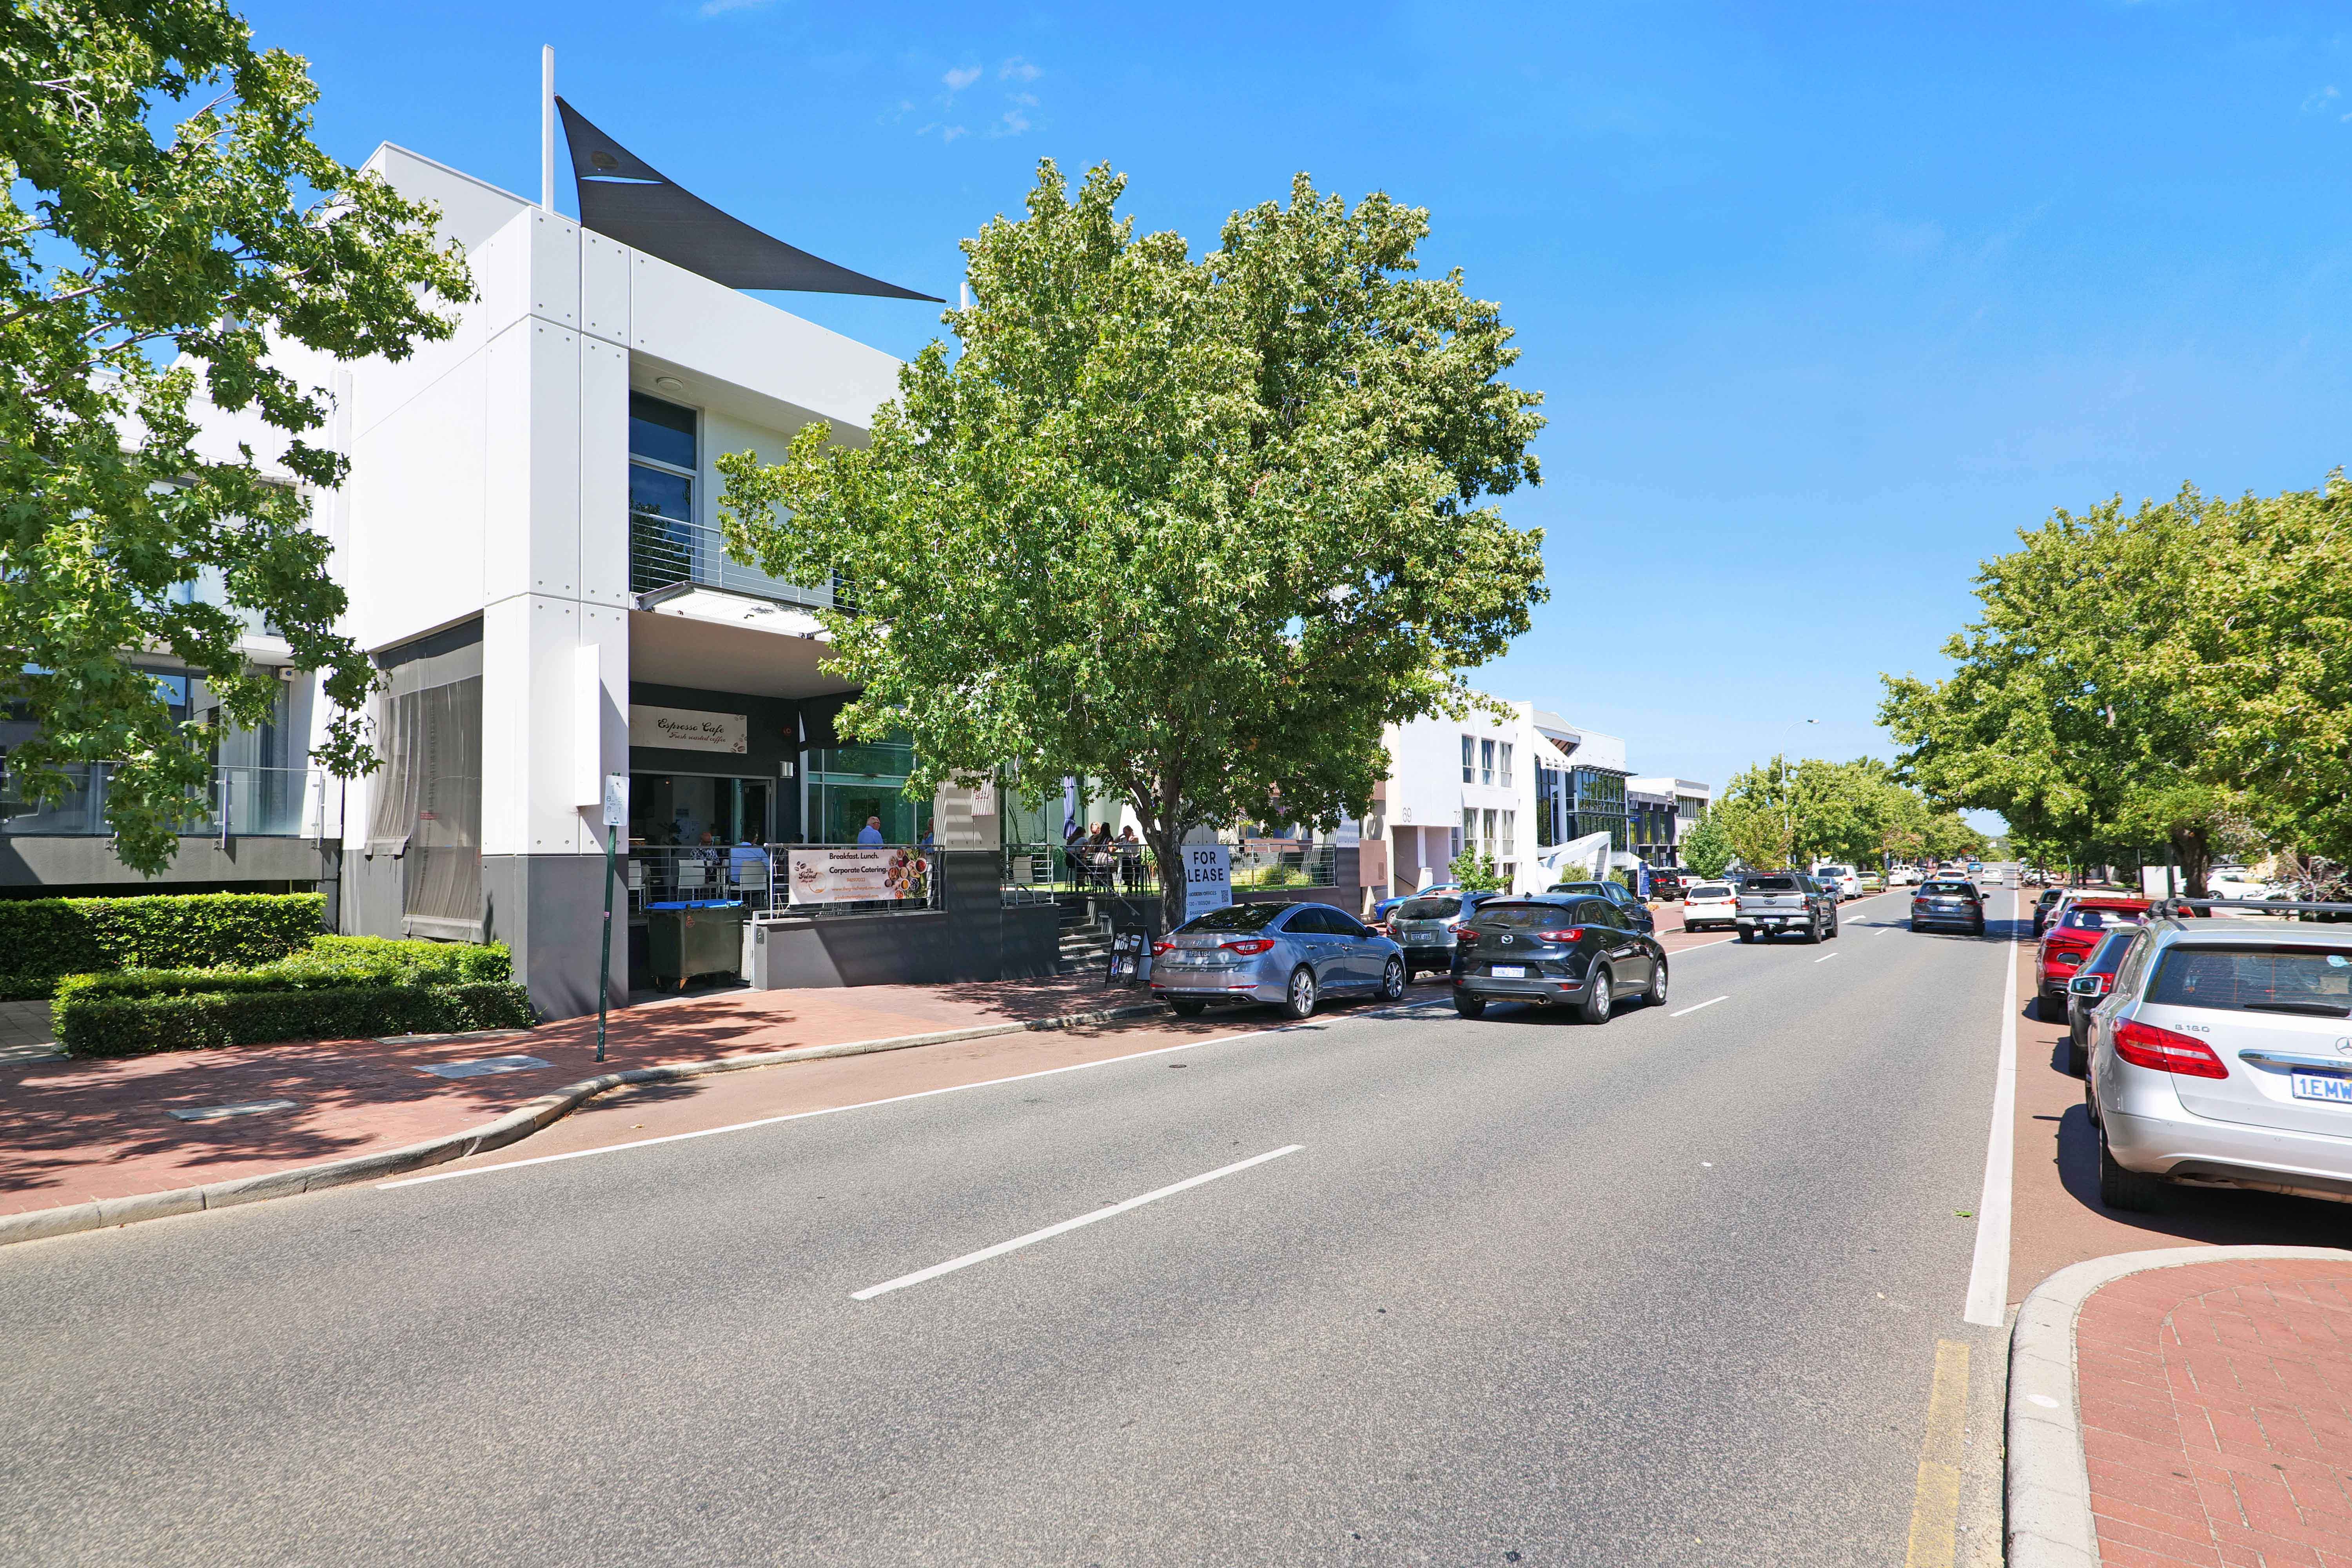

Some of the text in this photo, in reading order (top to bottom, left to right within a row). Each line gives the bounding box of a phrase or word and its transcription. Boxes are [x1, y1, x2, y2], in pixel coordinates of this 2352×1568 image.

[658, 719, 724, 736] Espresso Cafe
[1403, 807, 1411, 822] 69
[1454, 811, 1461, 824] 73
[1193, 851, 1216, 864] FOR
[1188, 868, 1224, 882] LEASE
[1114, 939, 1129, 950] NOW
